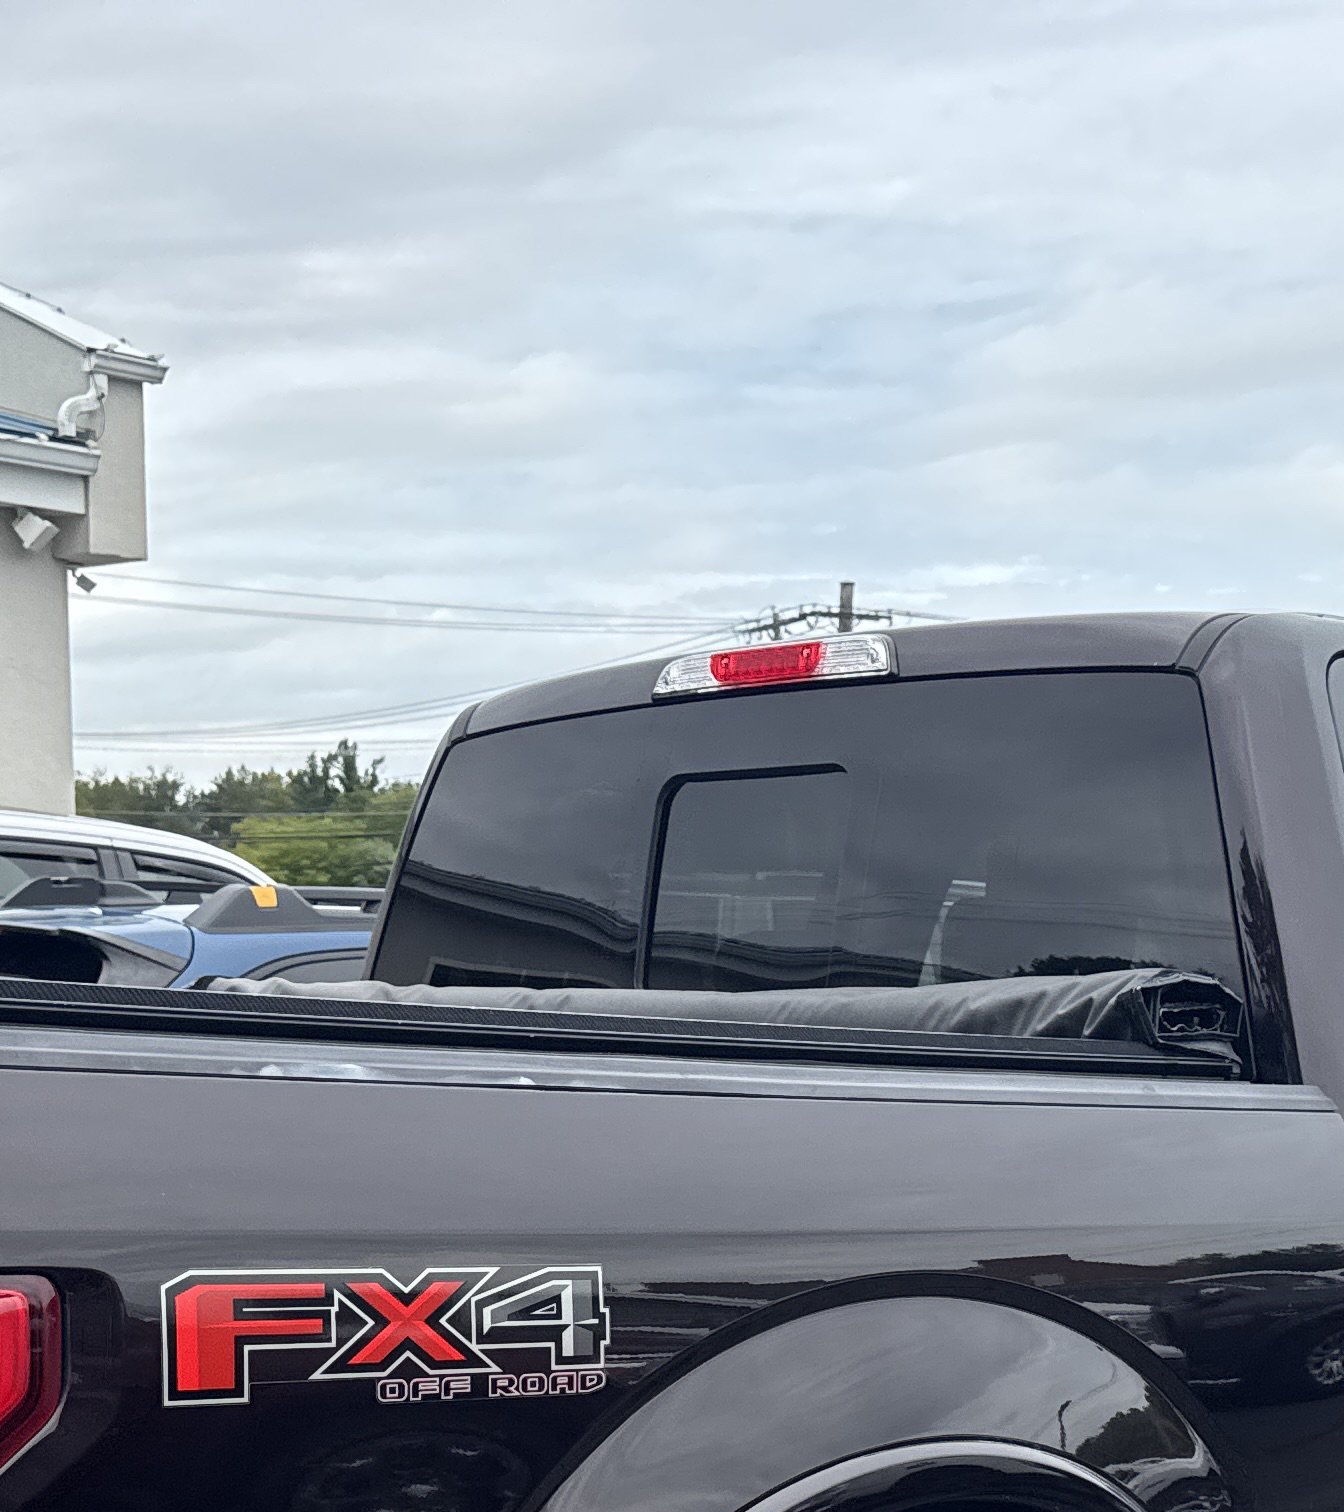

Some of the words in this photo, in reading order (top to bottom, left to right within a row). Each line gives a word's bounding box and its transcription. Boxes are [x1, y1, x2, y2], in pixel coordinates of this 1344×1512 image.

[161, 1266, 609, 1407] FX4
[377, 1376, 471, 1402] OFF
[488, 1370, 608, 1398] ROAD
